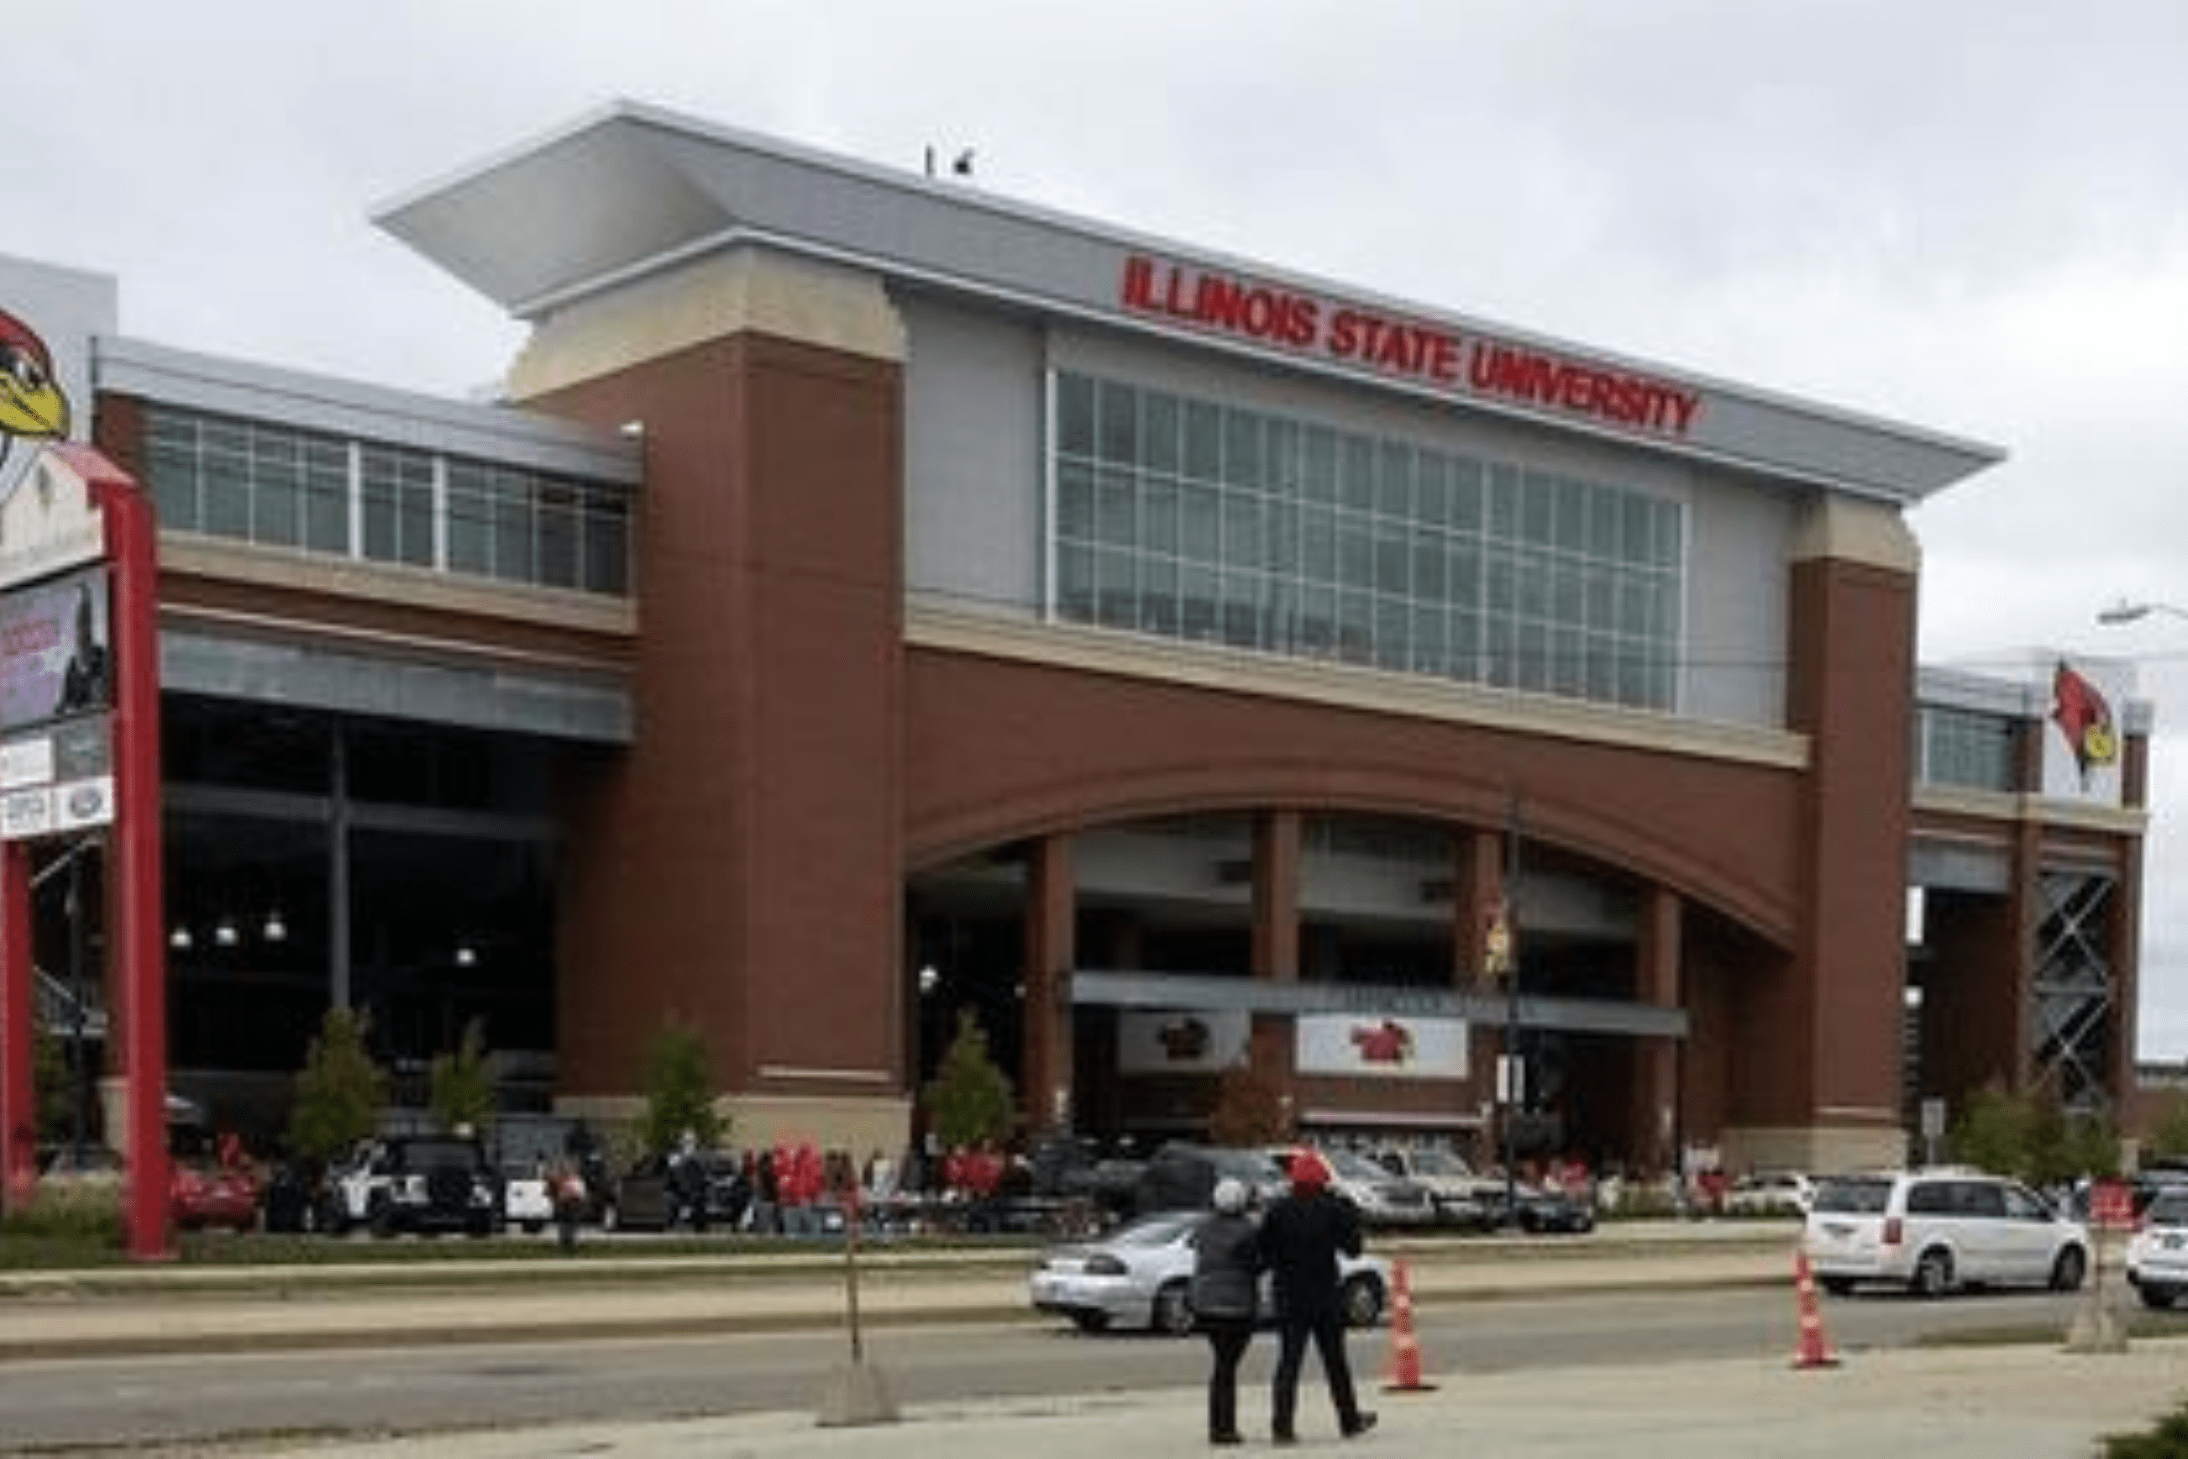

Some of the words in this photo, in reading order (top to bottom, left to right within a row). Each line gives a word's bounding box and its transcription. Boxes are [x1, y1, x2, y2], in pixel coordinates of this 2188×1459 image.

[1122, 256, 1317, 346] ILLINOIS
[1329, 309, 1462, 380] STATE
[1471, 342, 1701, 434] UNIVERSITY
